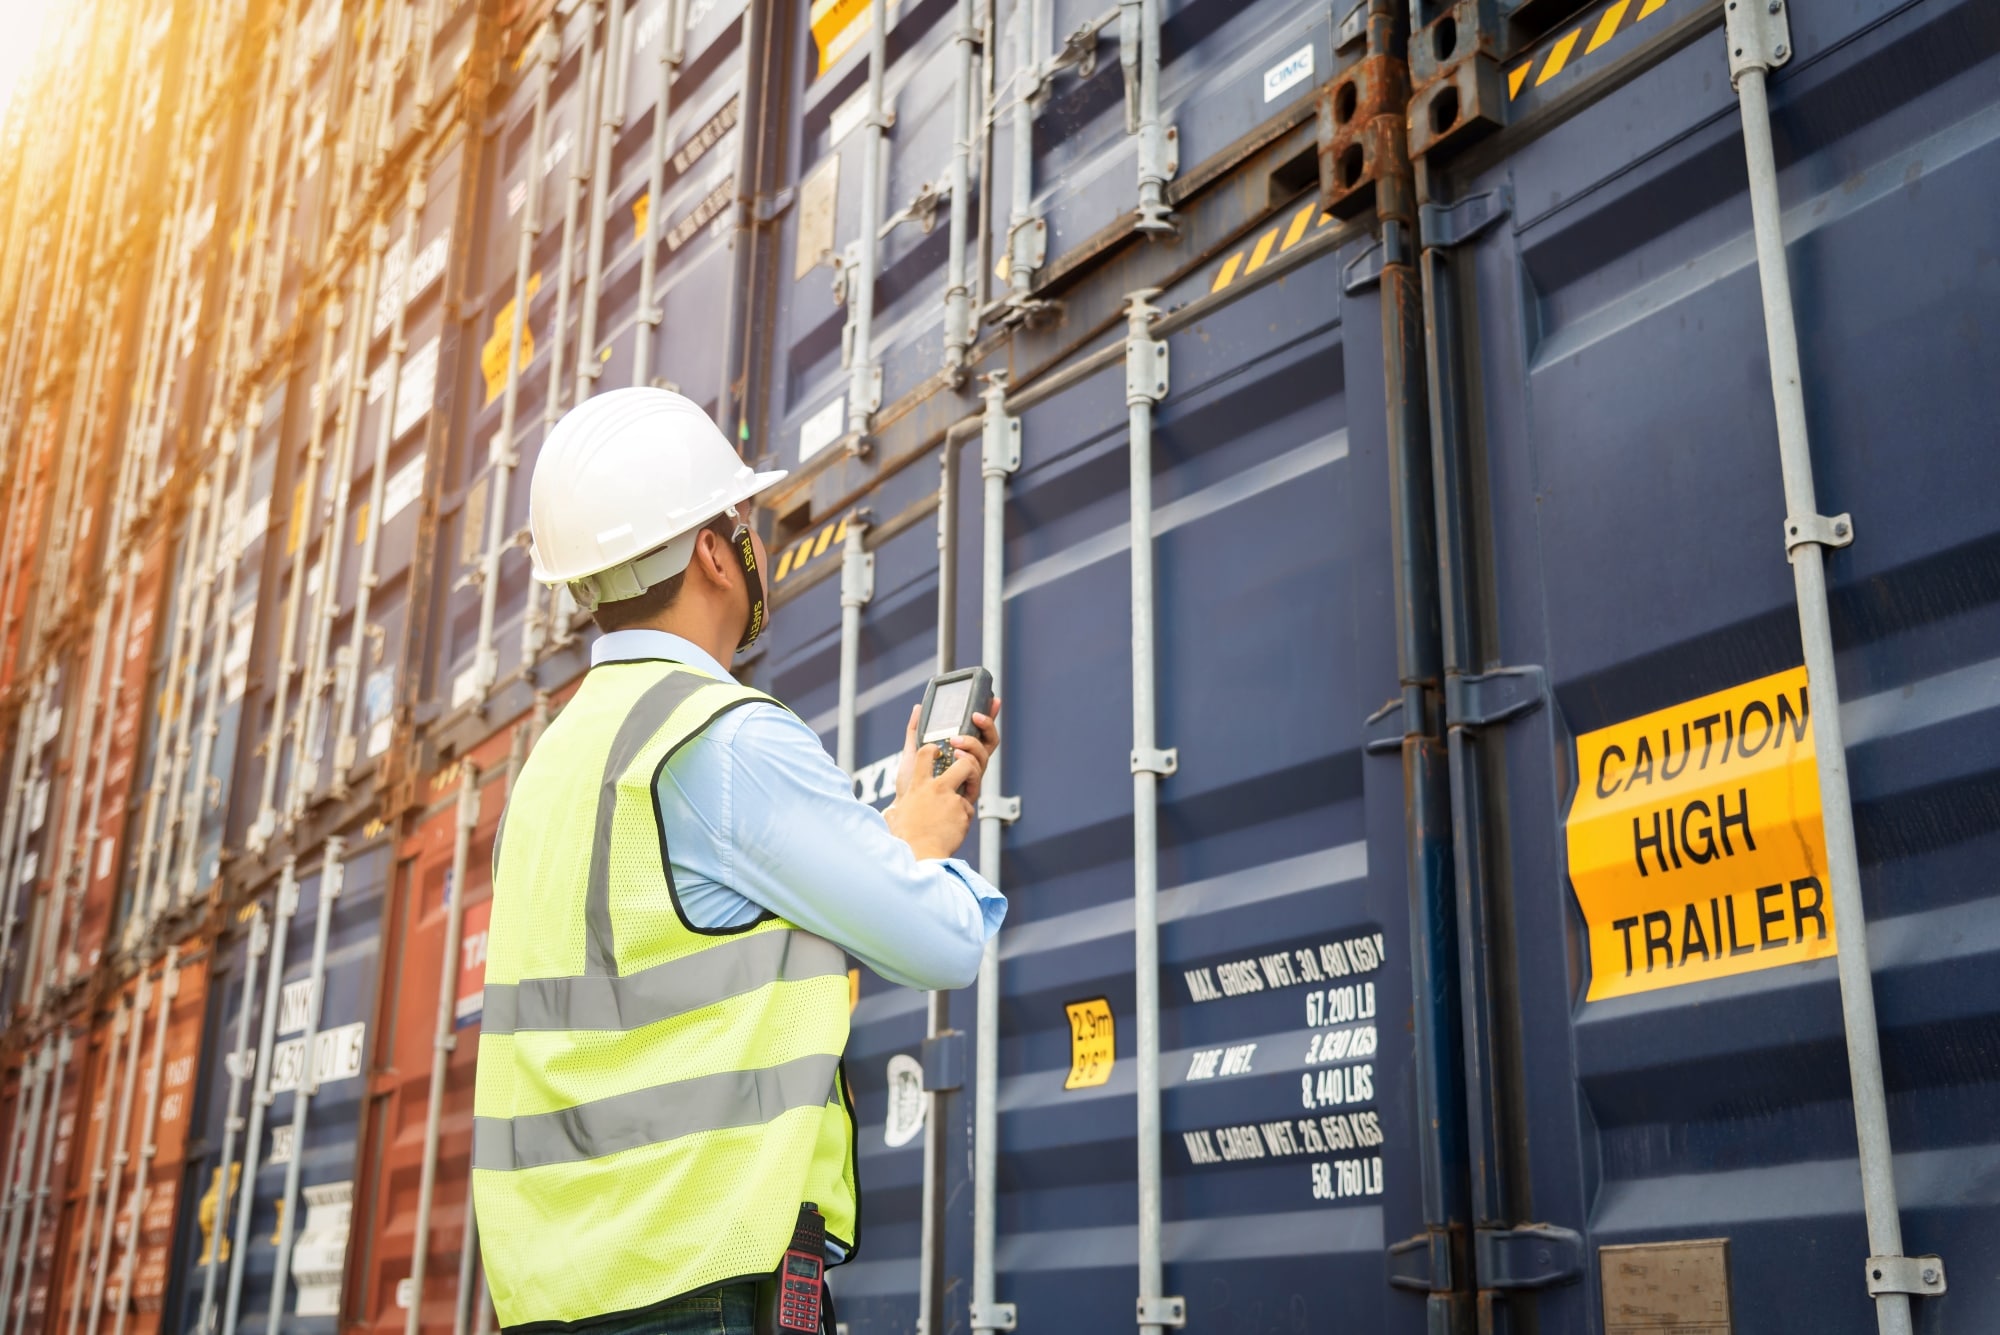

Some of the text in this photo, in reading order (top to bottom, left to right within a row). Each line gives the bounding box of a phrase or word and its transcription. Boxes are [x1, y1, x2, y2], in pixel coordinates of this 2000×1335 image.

[1269, 53, 1308, 88] CIMC
[741, 537, 763, 641] FIRST SAFETY
[1596, 686, 1810, 799] CAUTION
[1633, 788, 1756, 877] HIGH
[1613, 876, 1827, 977] TRAILER
[1217, 960, 1264, 997] GROSS
[1345, 1064, 1374, 1103] LBS
[1215, 1125, 1265, 1161] CARGO
[1349, 1111, 1383, 1148] KGS
